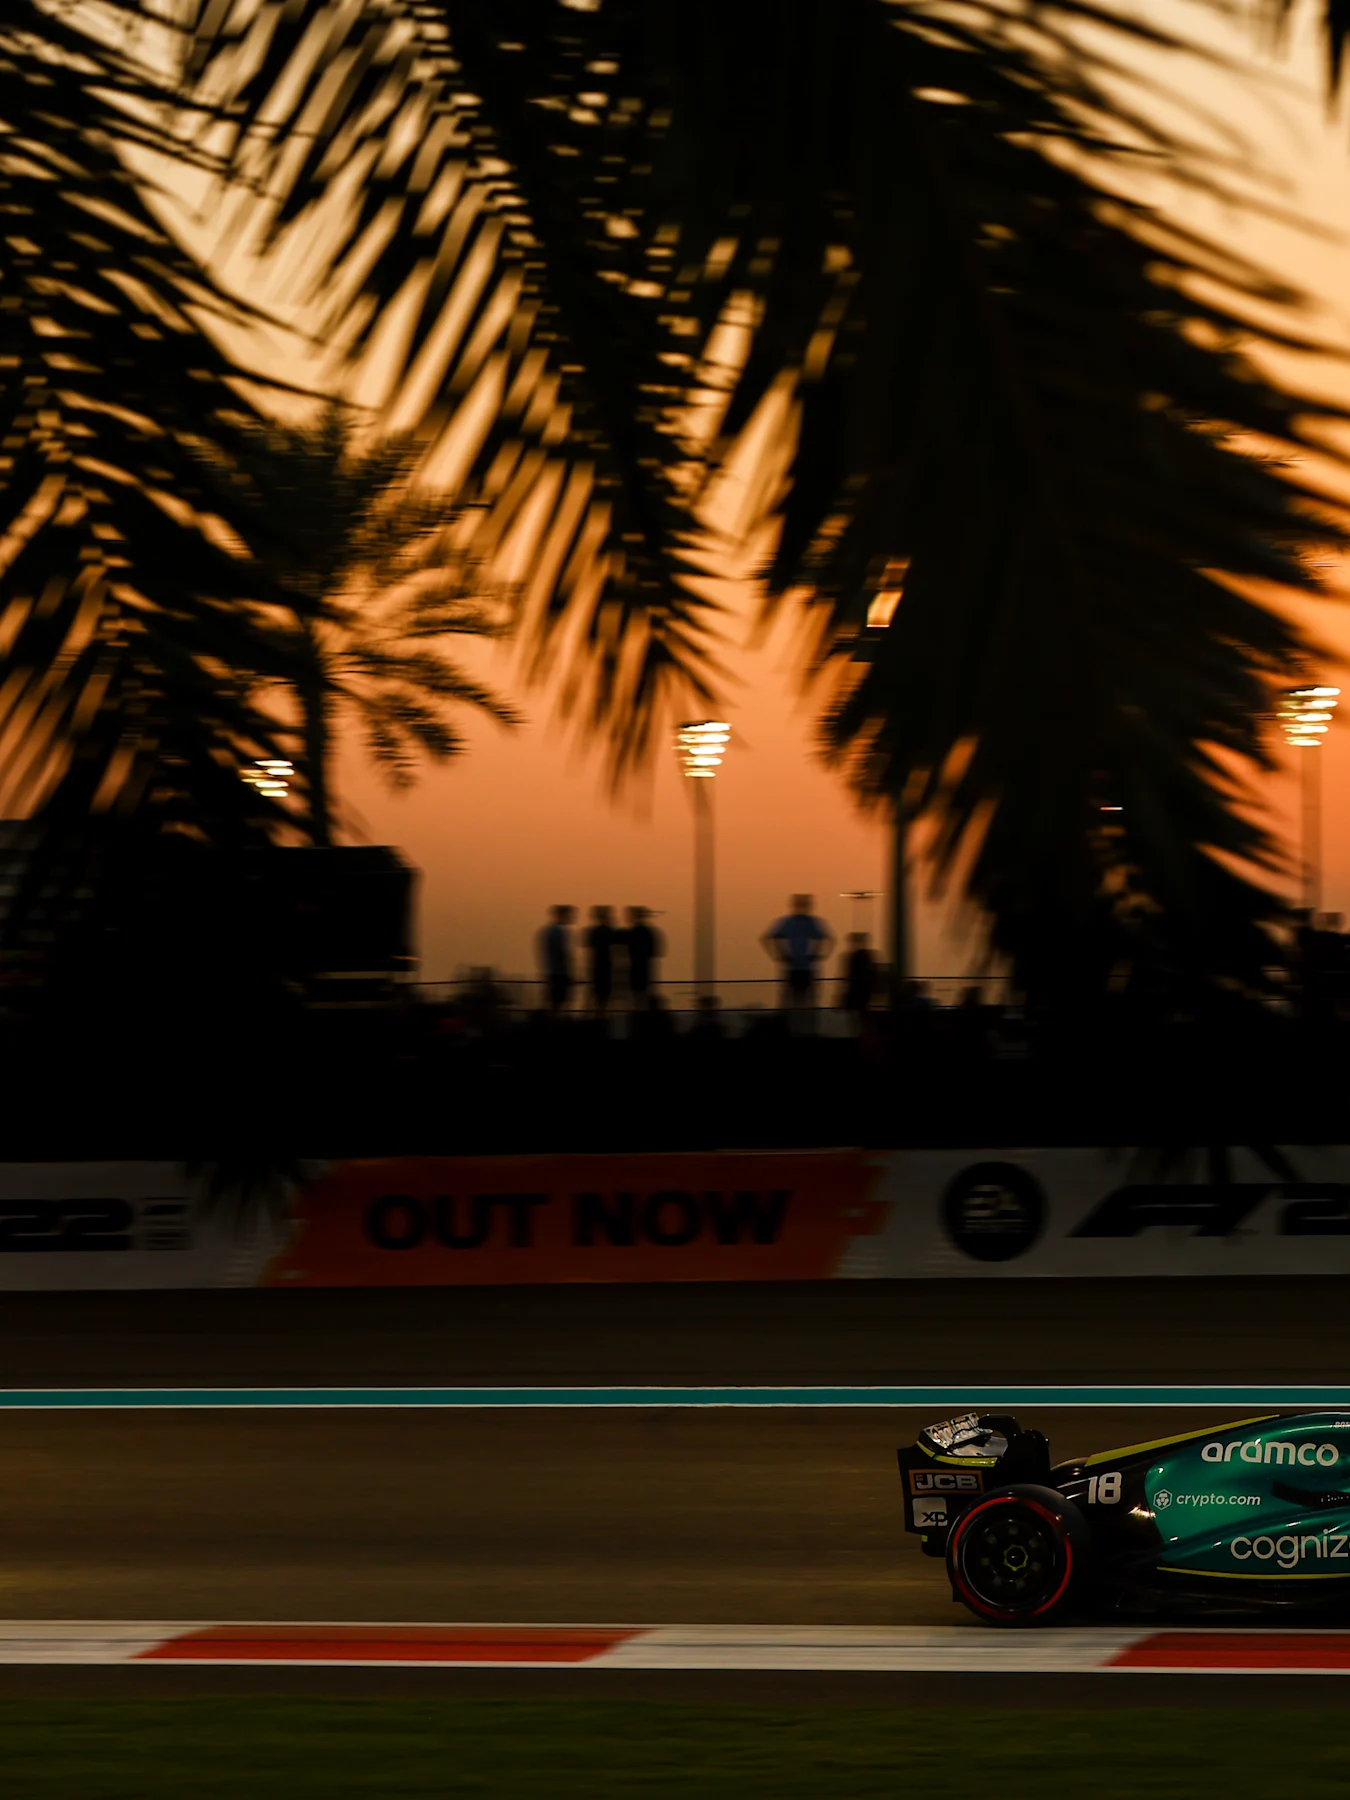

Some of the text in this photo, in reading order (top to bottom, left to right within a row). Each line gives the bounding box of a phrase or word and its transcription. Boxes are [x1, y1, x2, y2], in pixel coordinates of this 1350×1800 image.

[363, 1189, 794, 1249] OUT NOW
[1200, 1440, 1340, 1466] aramco
[915, 1472, 978, 1490] JCB
[1087, 1471, 1122, 1505] 18
[1176, 1493, 1261, 1506] crypto.com
